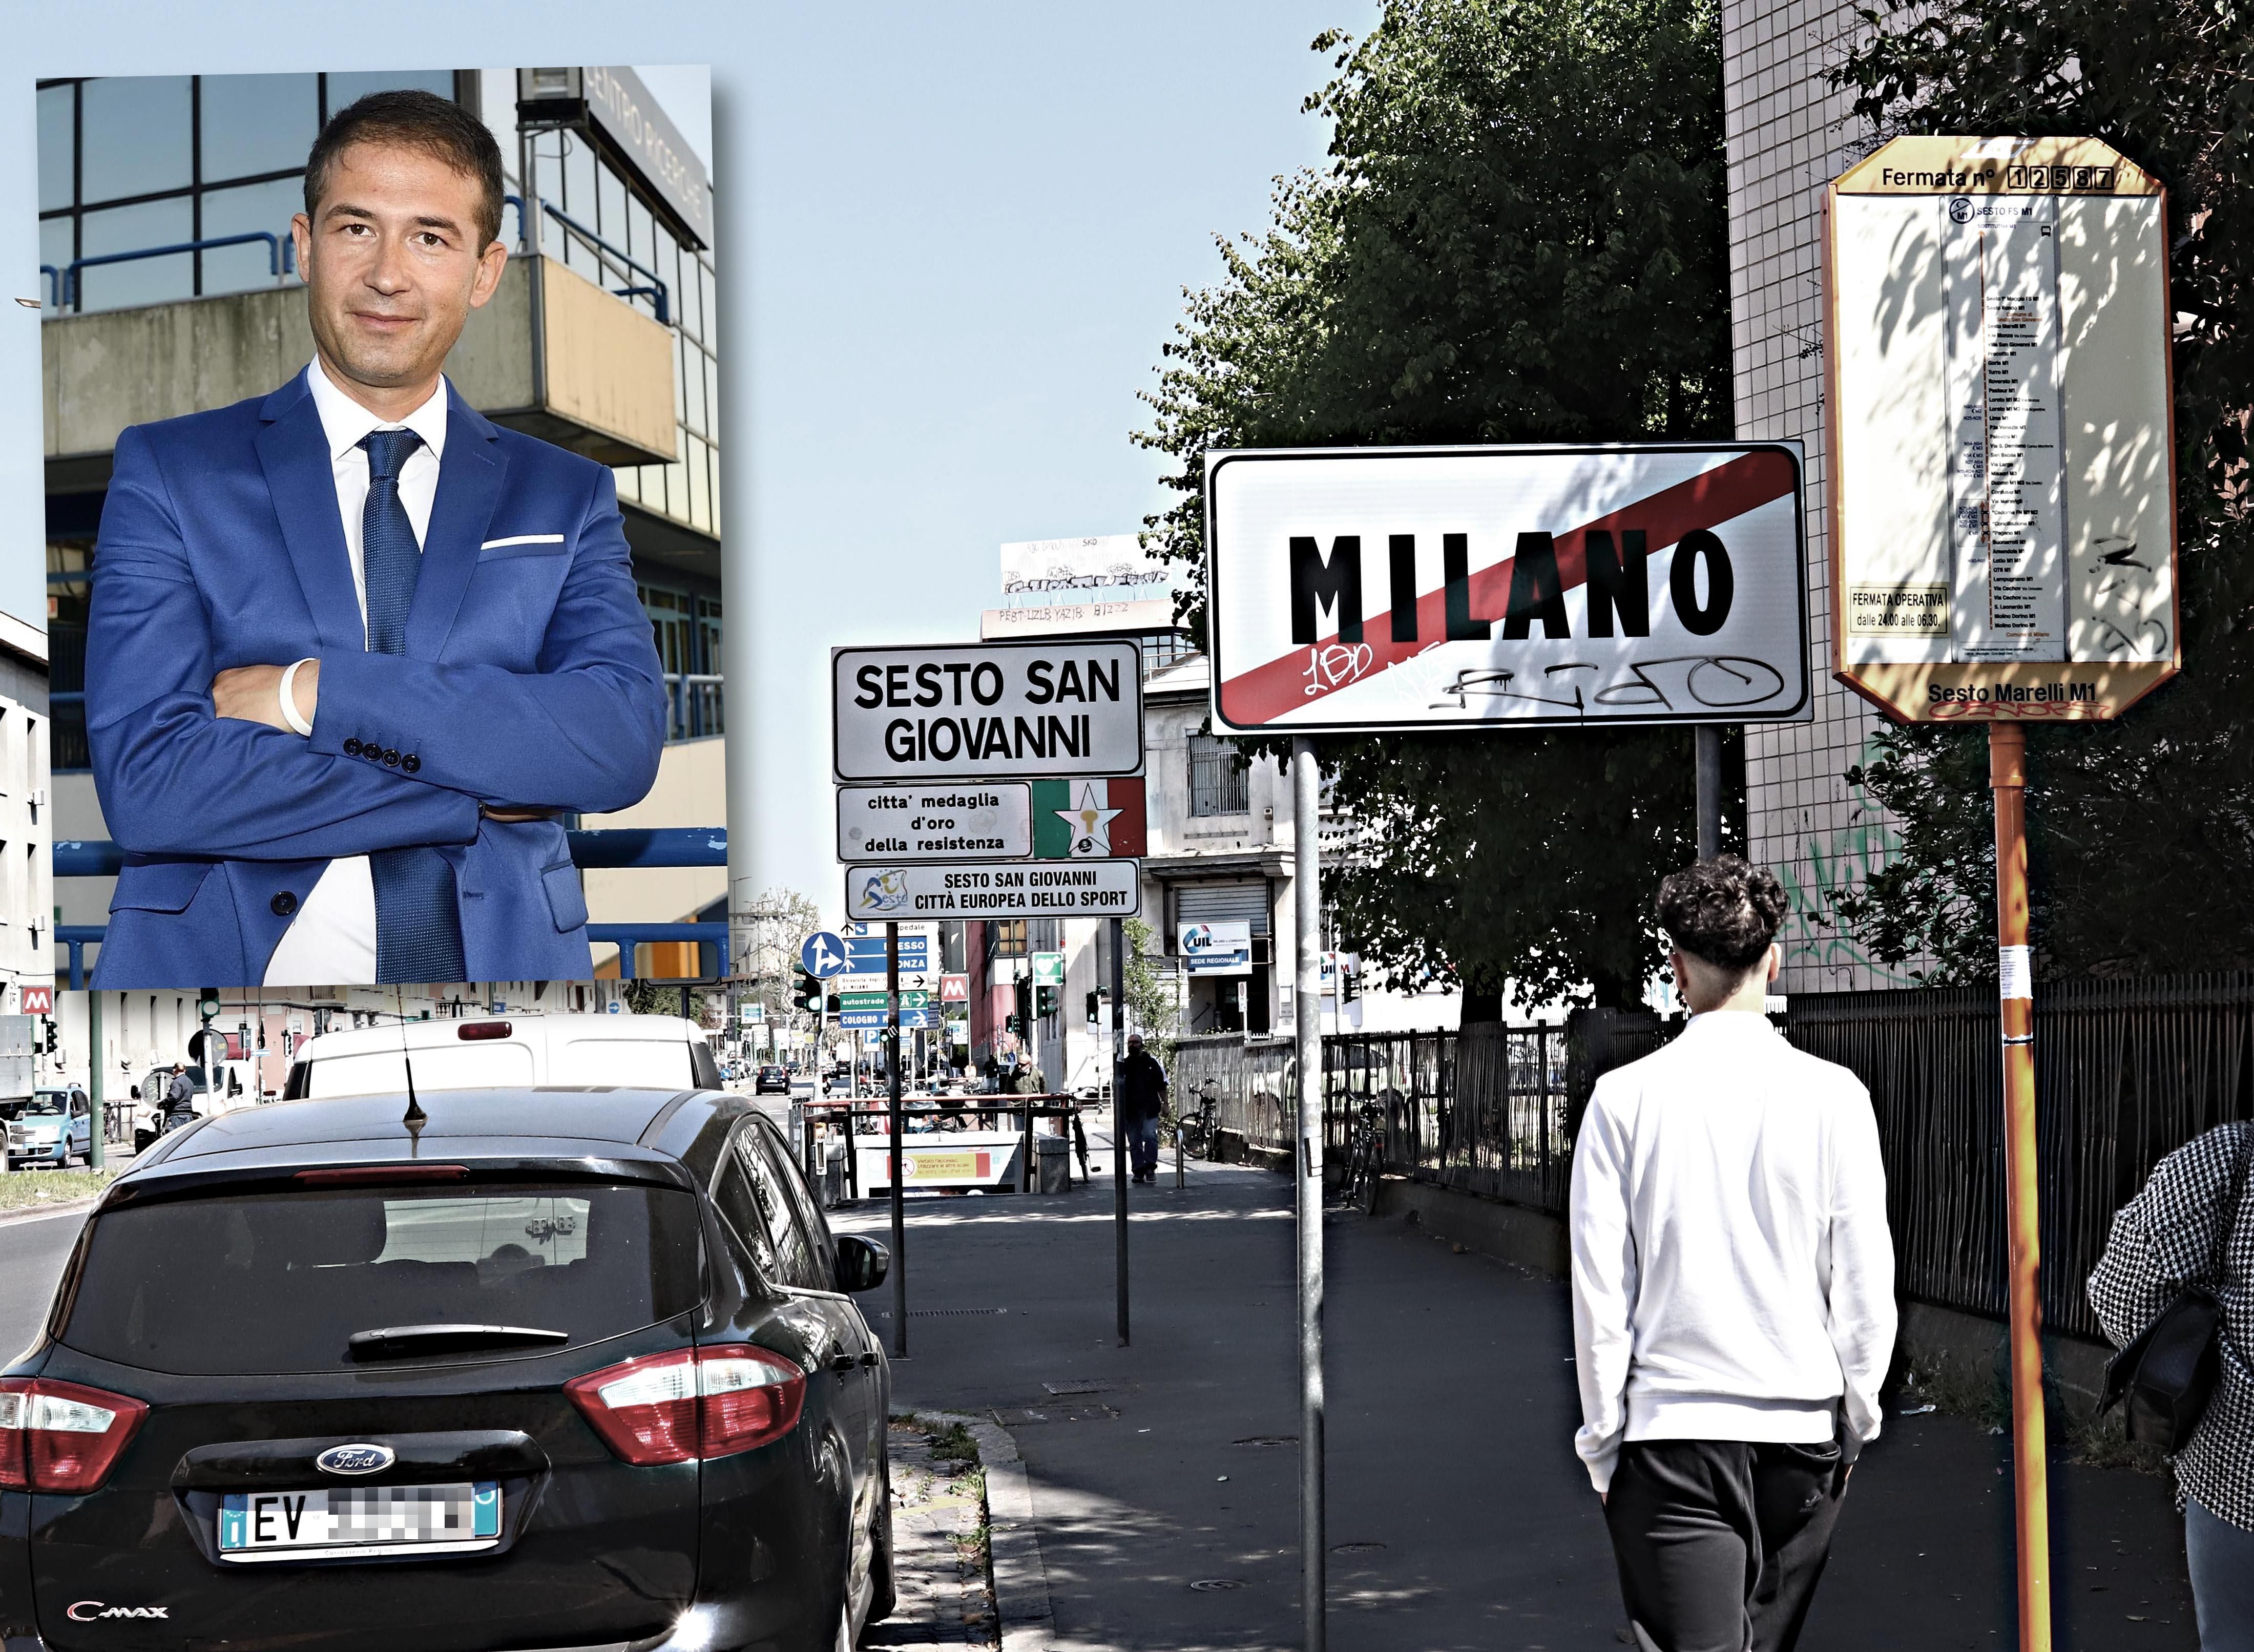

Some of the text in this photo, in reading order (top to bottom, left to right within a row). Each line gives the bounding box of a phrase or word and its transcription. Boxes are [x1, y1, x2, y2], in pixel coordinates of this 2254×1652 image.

[1883, 168, 1967, 186] Fermata
[1973, 169, 1995, 186] n°
[1289, 529, 1734, 645] MILANO
[1853, 593, 1944, 607] FERMATA OPERATIVA
[1858, 614, 1875, 626] dalle
[1879, 614, 1898, 626] 24.00
[1902, 614, 1914, 626] alle
[854, 659, 1120, 709] SESTO SAN
[1929, 683, 2095, 702] Sesto Marelli M1
[885, 715, 1091, 763] GIOVANNI
[868, 792, 999, 809] citta' medaglia
[911, 816, 955, 830] d'oro
[865, 837, 1005, 851] della resistenza
[945, 871, 1097, 888] SESTO SAN GIOVANNI
[915, 890, 1127, 910] CITTÀ EUROPEA DELLO SPORT
[1194, 937, 1212, 947] UIL
[898, 959, 925, 969] ONZA
[944, 980, 965, 996] M
[25, 992, 50, 1009] M
[842, 1015, 878, 1024] COLOGNO
[867, 1030, 877, 1043] P
[333, 1450, 375, 1468] Ford
[255, 1495, 306, 1542] EV
